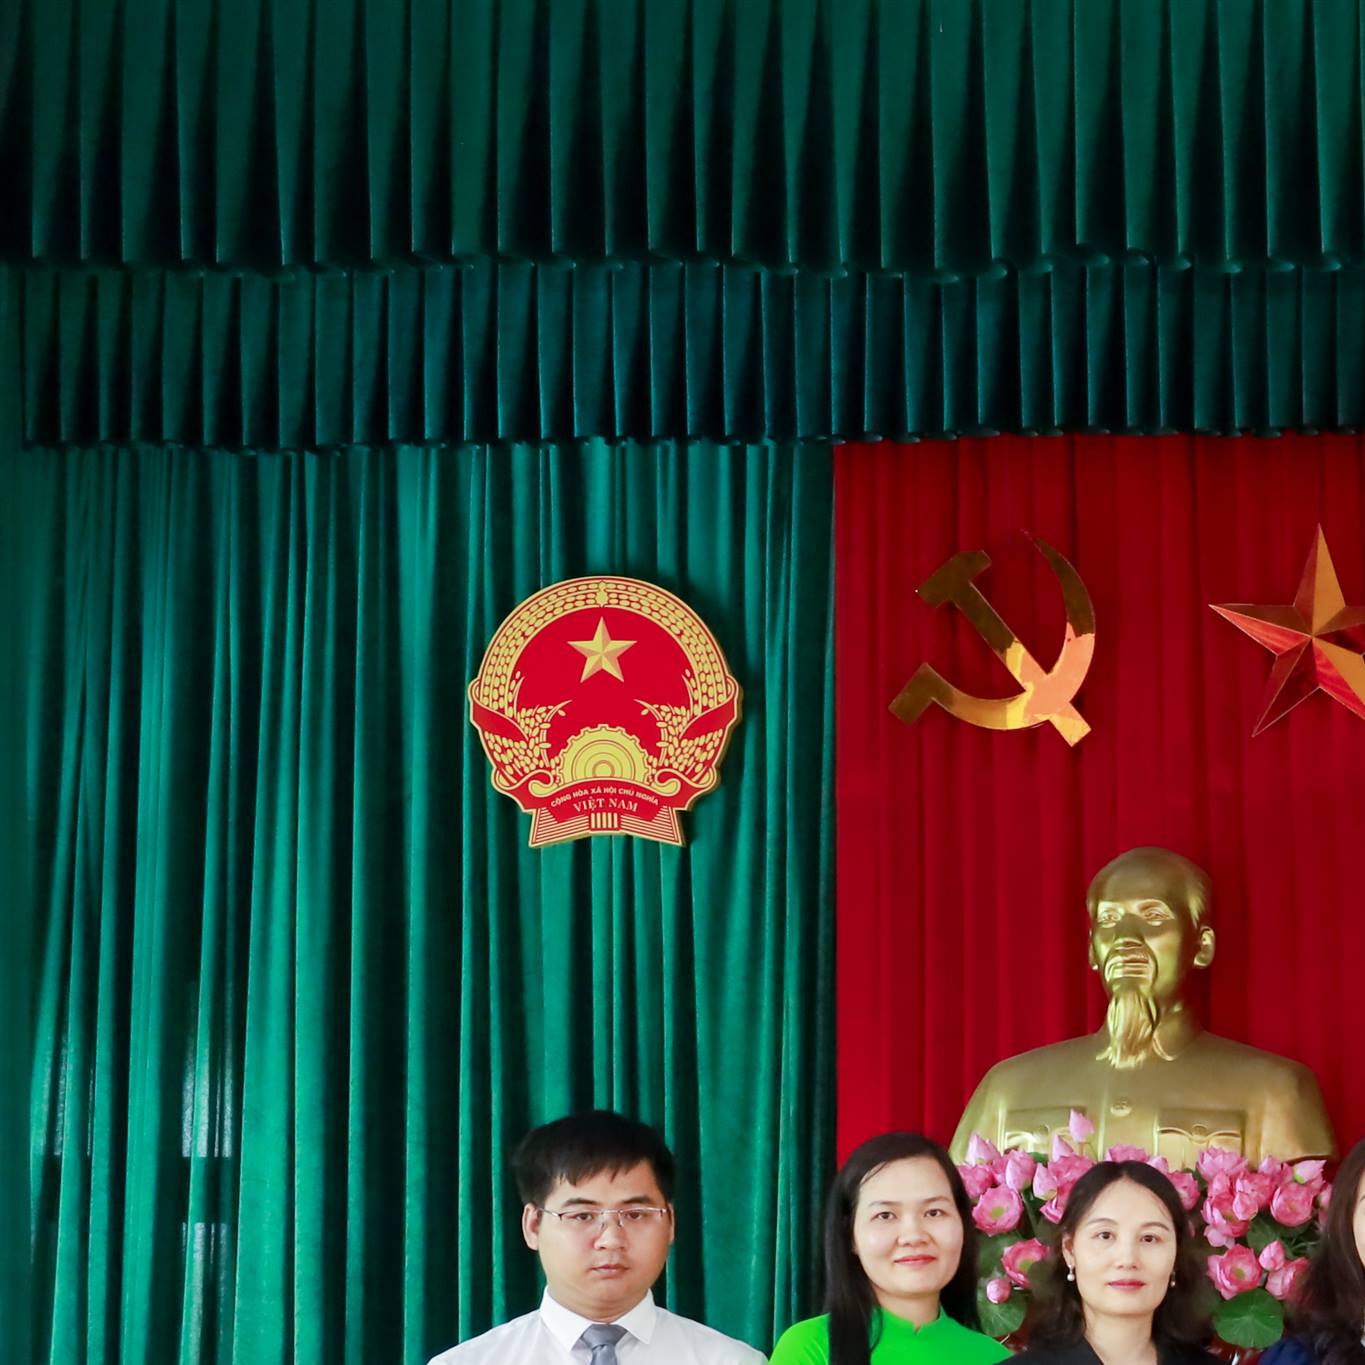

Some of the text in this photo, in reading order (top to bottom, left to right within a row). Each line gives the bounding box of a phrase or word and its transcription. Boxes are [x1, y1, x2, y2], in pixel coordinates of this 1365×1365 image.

[550, 794, 571, 807] CỘNG
[573, 788, 589, 798] HÒA
[603, 786, 617, 795] HỘI
[573, 796, 638, 812] VIỆT NAM
